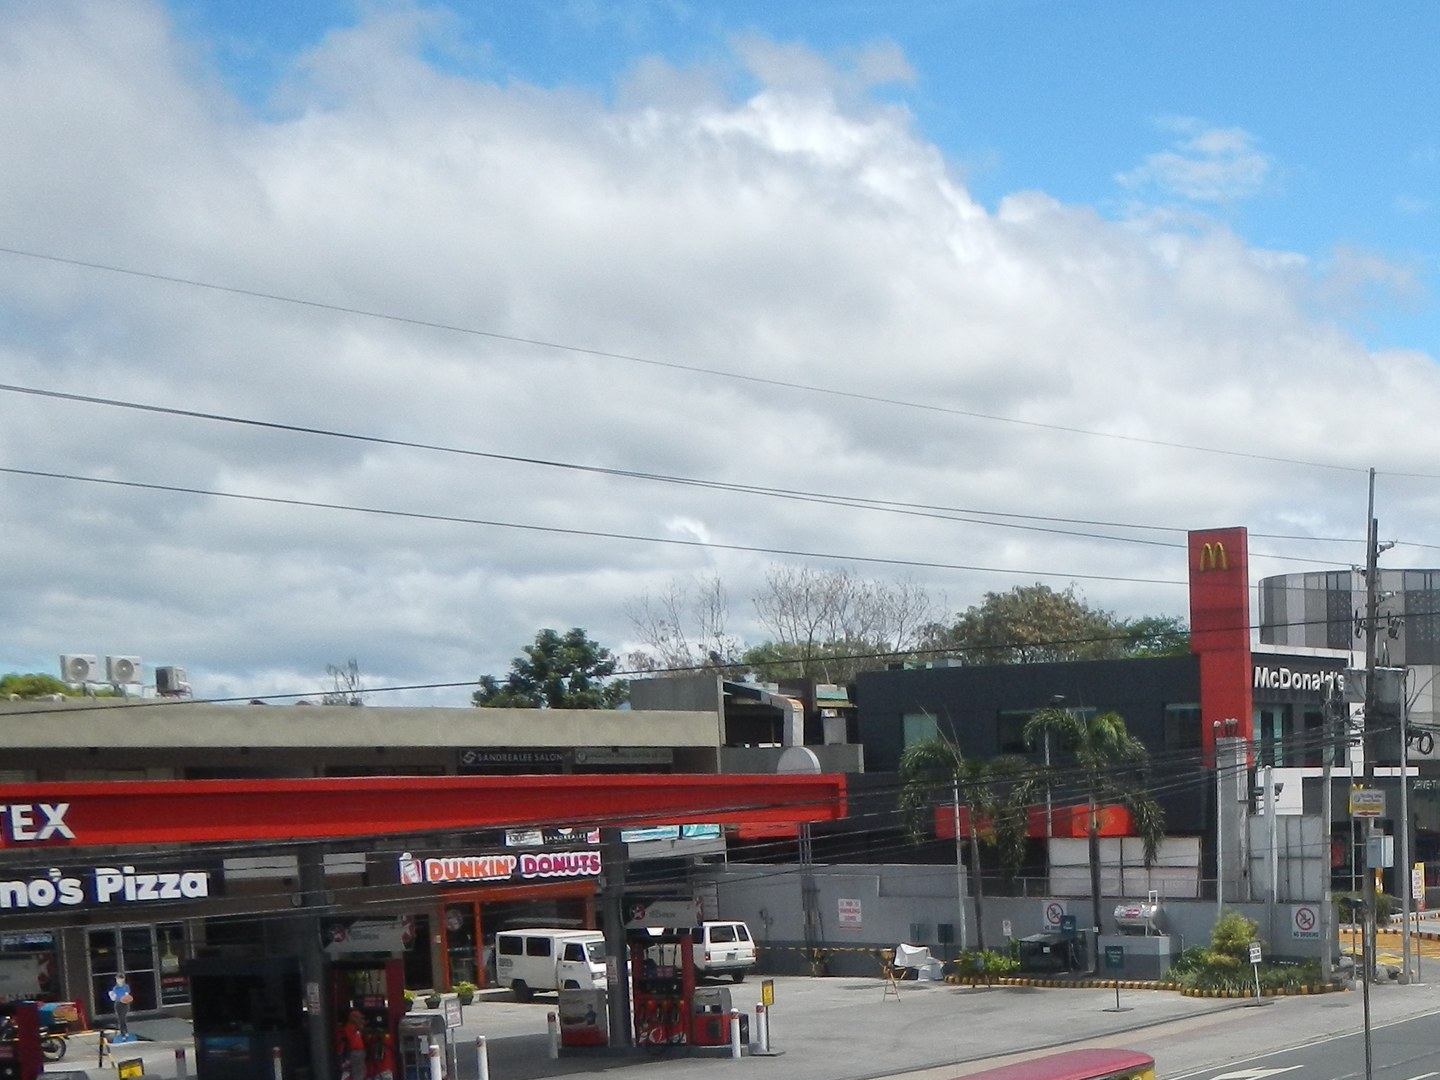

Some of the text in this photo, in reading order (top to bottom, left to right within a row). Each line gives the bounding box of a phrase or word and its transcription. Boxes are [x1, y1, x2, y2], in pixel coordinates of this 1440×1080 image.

[535, 751, 563, 761] SALON
[0, 803, 76, 842] EX
[428, 853, 601, 880] DUNKIN' DONUTS
[95, 865, 209, 903] Pizza
